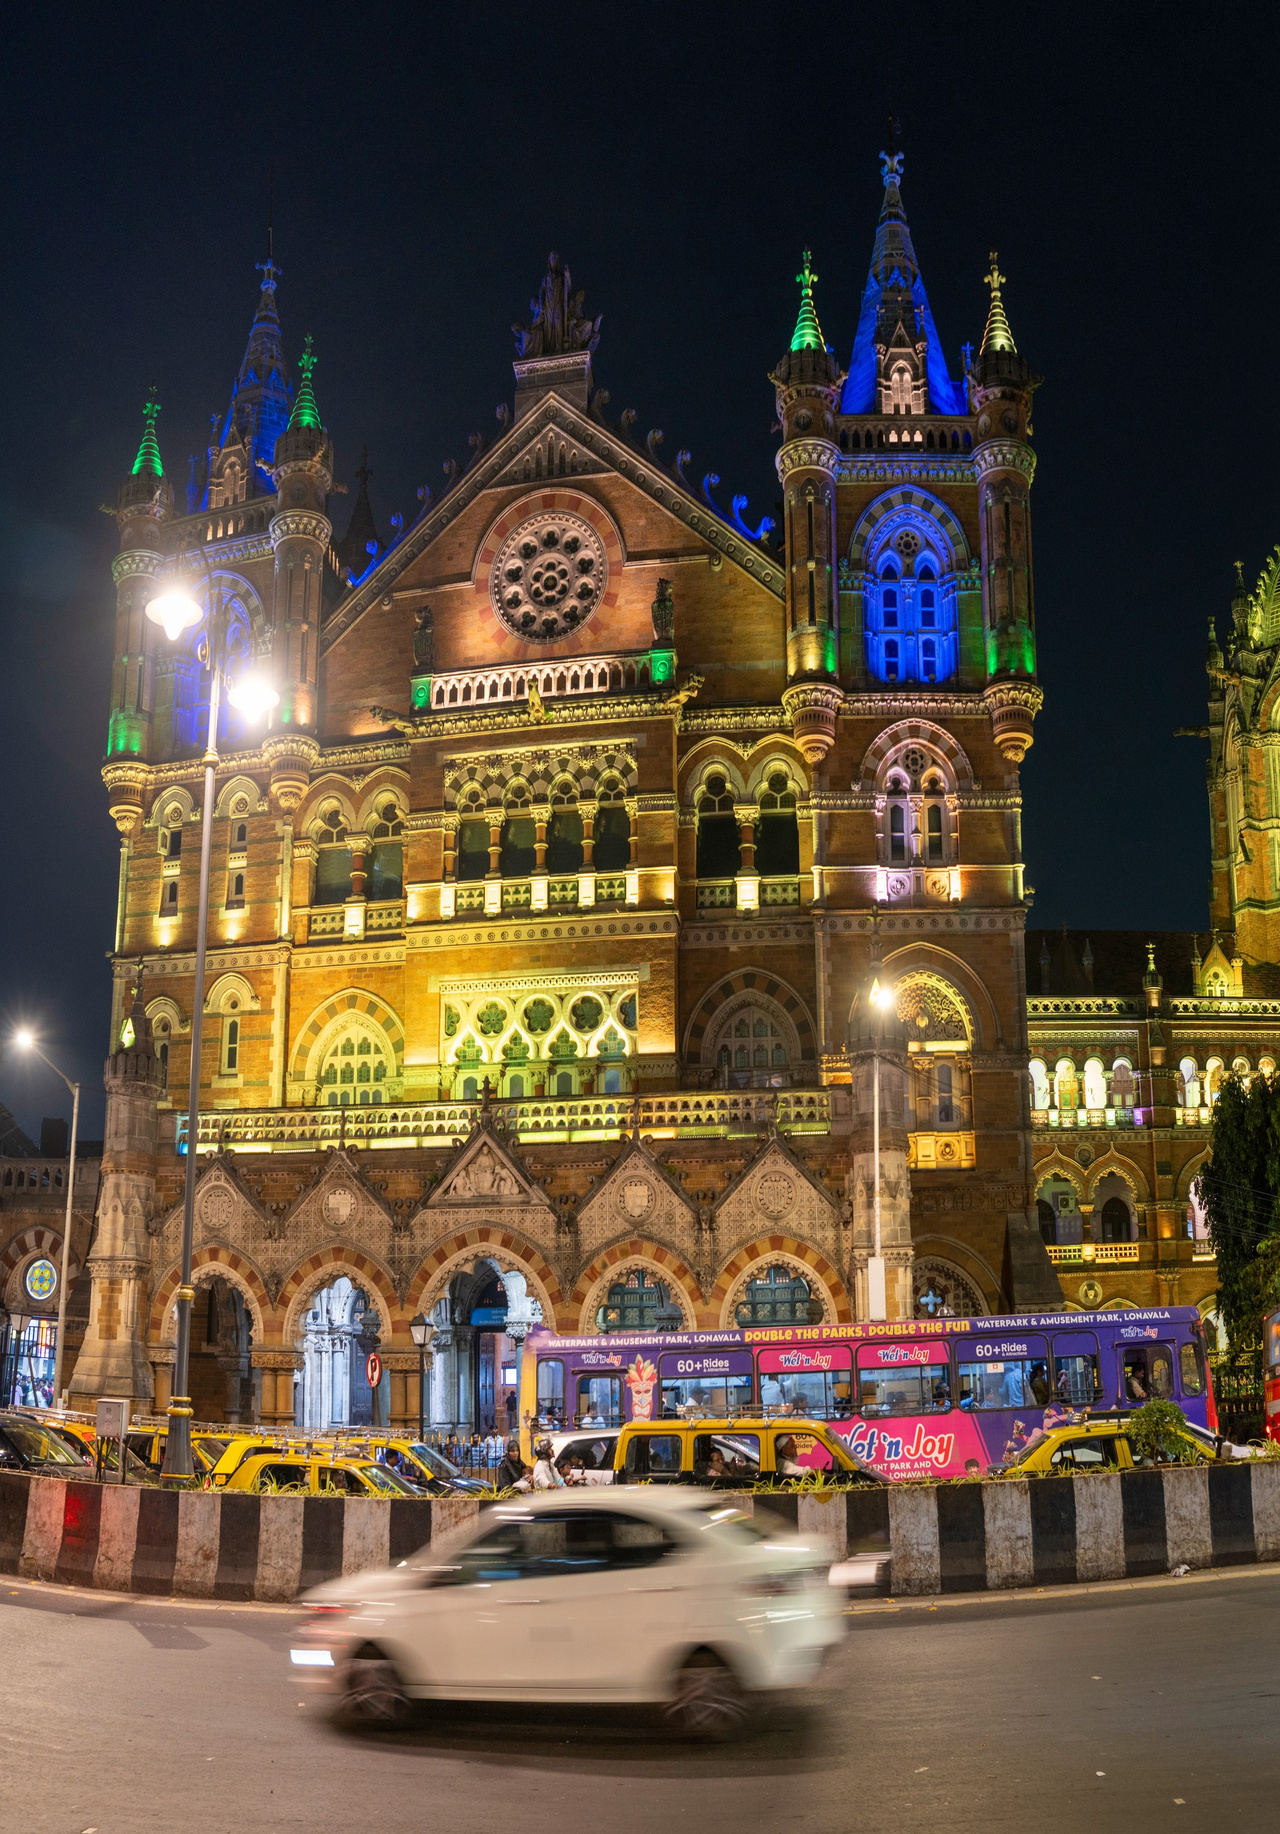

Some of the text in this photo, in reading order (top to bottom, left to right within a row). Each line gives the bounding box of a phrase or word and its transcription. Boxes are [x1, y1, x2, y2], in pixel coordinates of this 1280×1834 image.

[976, 1311, 1171, 1328] WATERPARK & AMUSEMENT PARK, LONAVALA
[822, 1326, 866, 1338] PARKS,
[1144, 1325, 1158, 1338] Joy
[548, 1339, 599, 1348] WATERPARK
[610, 1336, 664, 1346] AMUSEMENT
[666, 1334, 692, 1344] PARK,
[694, 1333, 741, 1343] LONAVALA
[877, 1345, 899, 1362] Wet
[910, 1346, 930, 1364] Joy
[975, 1343, 1028, 1357] 60+ Rides
[581, 1350, 600, 1364] Wet
[606, 1352, 622, 1366] Joy
[677, 1358, 730, 1372] 60+ Rides
[779, 1350, 802, 1367] Wet
[811, 1351, 832, 1369] Joy
[904, 1423, 954, 1468] Joy
[889, 1462, 911, 1470] PARK
[913, 1460, 932, 1469] AND
